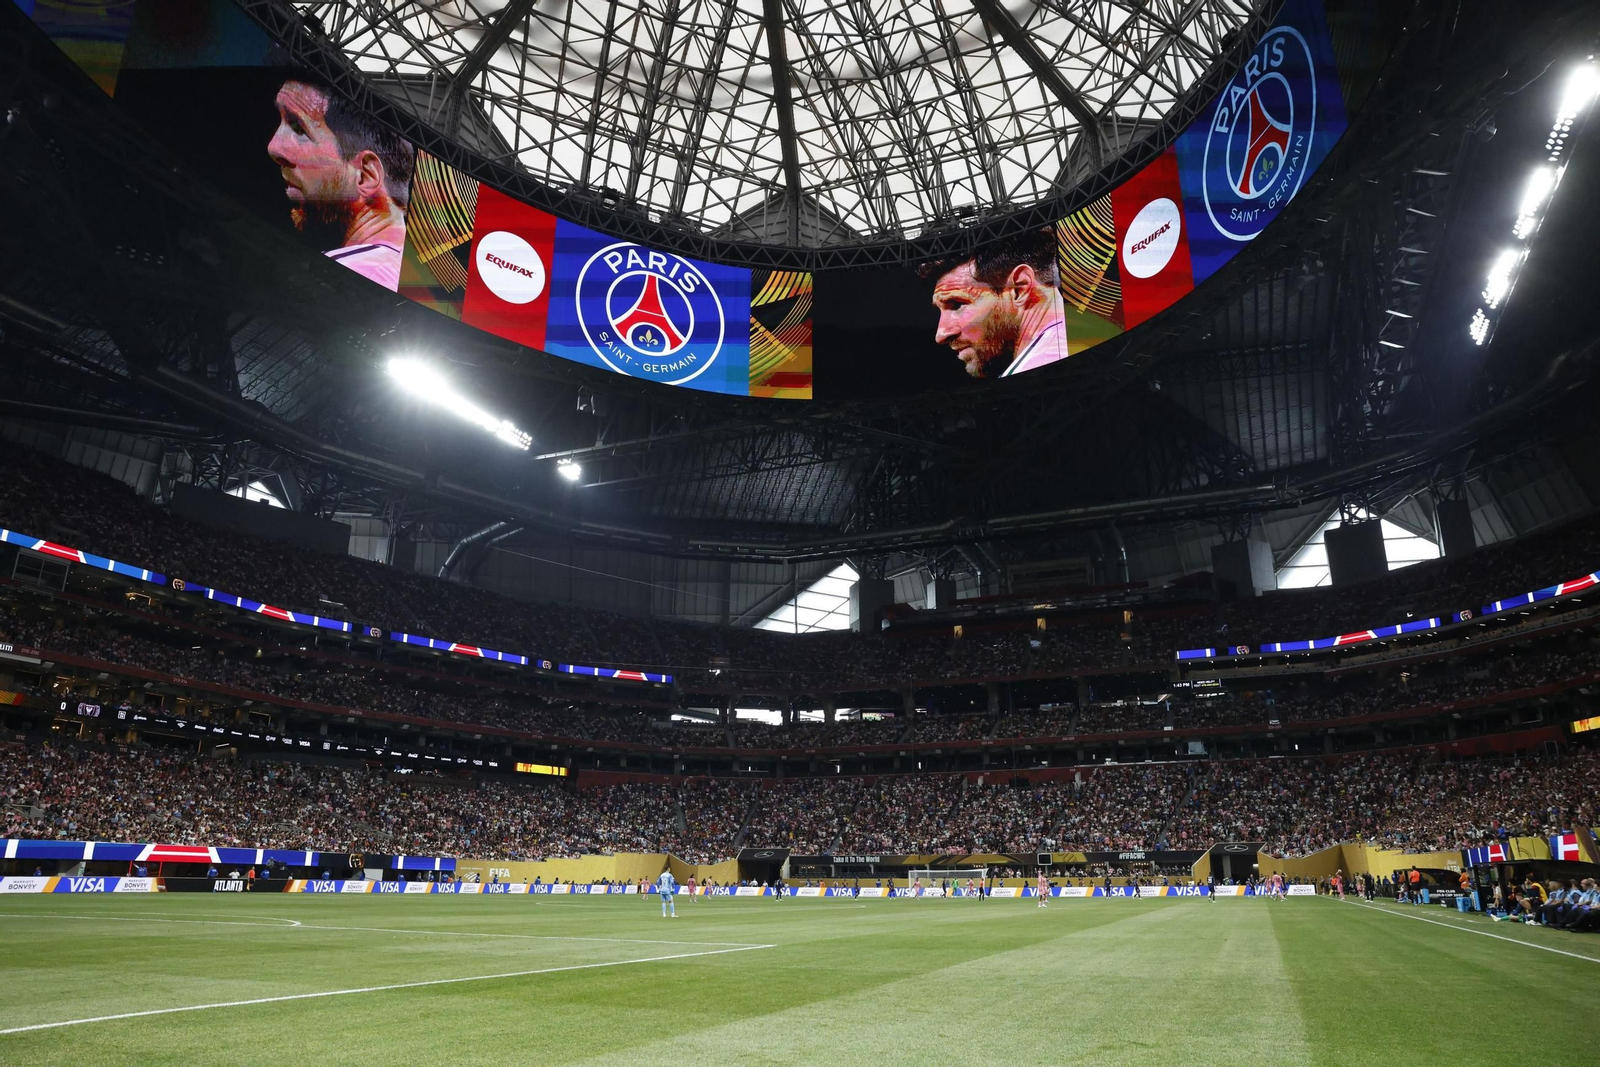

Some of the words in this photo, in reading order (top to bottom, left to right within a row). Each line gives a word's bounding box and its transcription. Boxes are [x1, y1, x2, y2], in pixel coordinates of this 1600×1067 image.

[1215, 37, 1285, 133] PARIS
[1229, 208, 1260, 222] SAINT
[1268, 135, 1304, 209] GERMAIN
[1131, 220, 1172, 255] EQUIFAX
[485, 253, 534, 278] EQUIFAX
[603, 249, 700, 293] PARIS
[599, 331, 632, 364] SAINT
[642, 352, 698, 373] GERMAIN
[61, 702, 66, 710] 0
[489, 868, 510, 877] FIFA
[67, 878, 104, 892] VISA
[214, 881, 243, 891] ATLANTA
[312, 881, 335, 892] VISA
[379, 882, 399, 893] VISA
[437, 883, 455, 893] VISA
[488, 884, 504, 893] VISA
[533, 885, 548, 893] VISA
[574, 885, 587, 893] VISA
[611, 885, 622, 893] VISA
[831, 888, 853, 896] VISA
[1174, 887, 1201, 895] VISA
